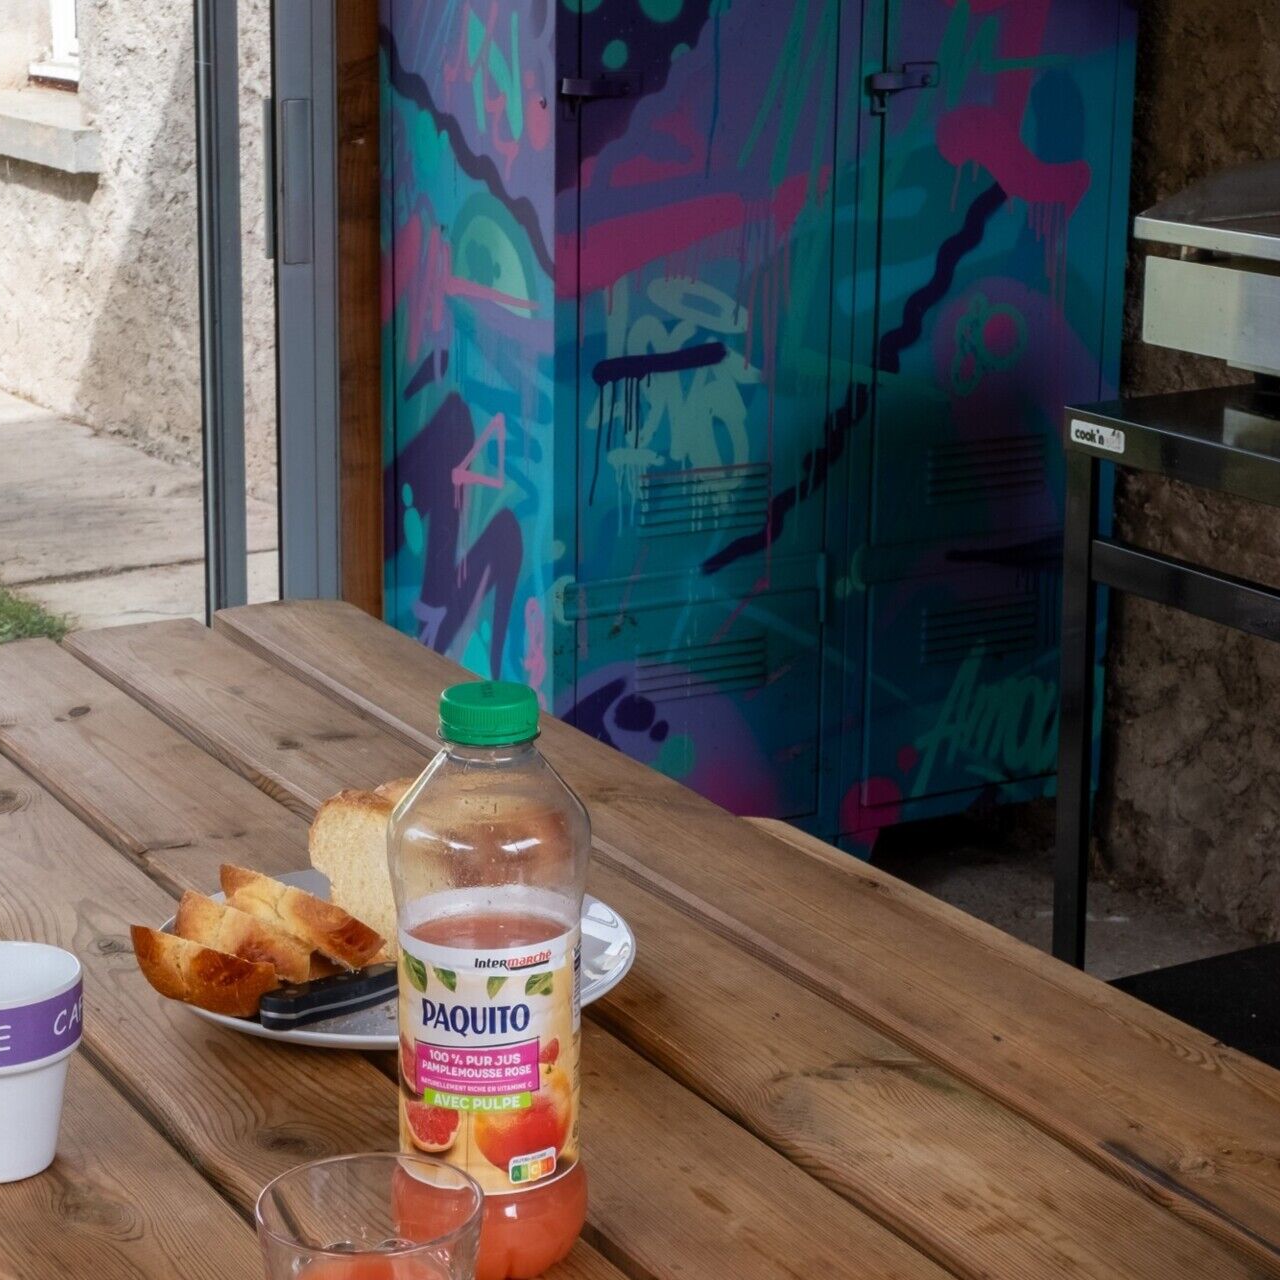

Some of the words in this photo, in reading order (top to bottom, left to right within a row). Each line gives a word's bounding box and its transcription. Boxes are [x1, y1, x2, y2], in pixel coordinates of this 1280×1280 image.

[422, 998, 530, 1037] PAQUITO
[429, 1049, 449, 1062] 100
[466, 1055, 493, 1066] PUR
[495, 1053, 521, 1066] JUS
[422, 1060, 503, 1078] PAMPLEMOUSSE
[505, 1064, 532, 1077] ROSE
[434, 1094, 470, 1109] AVEC
[473, 1095, 521, 1110] PULPE
